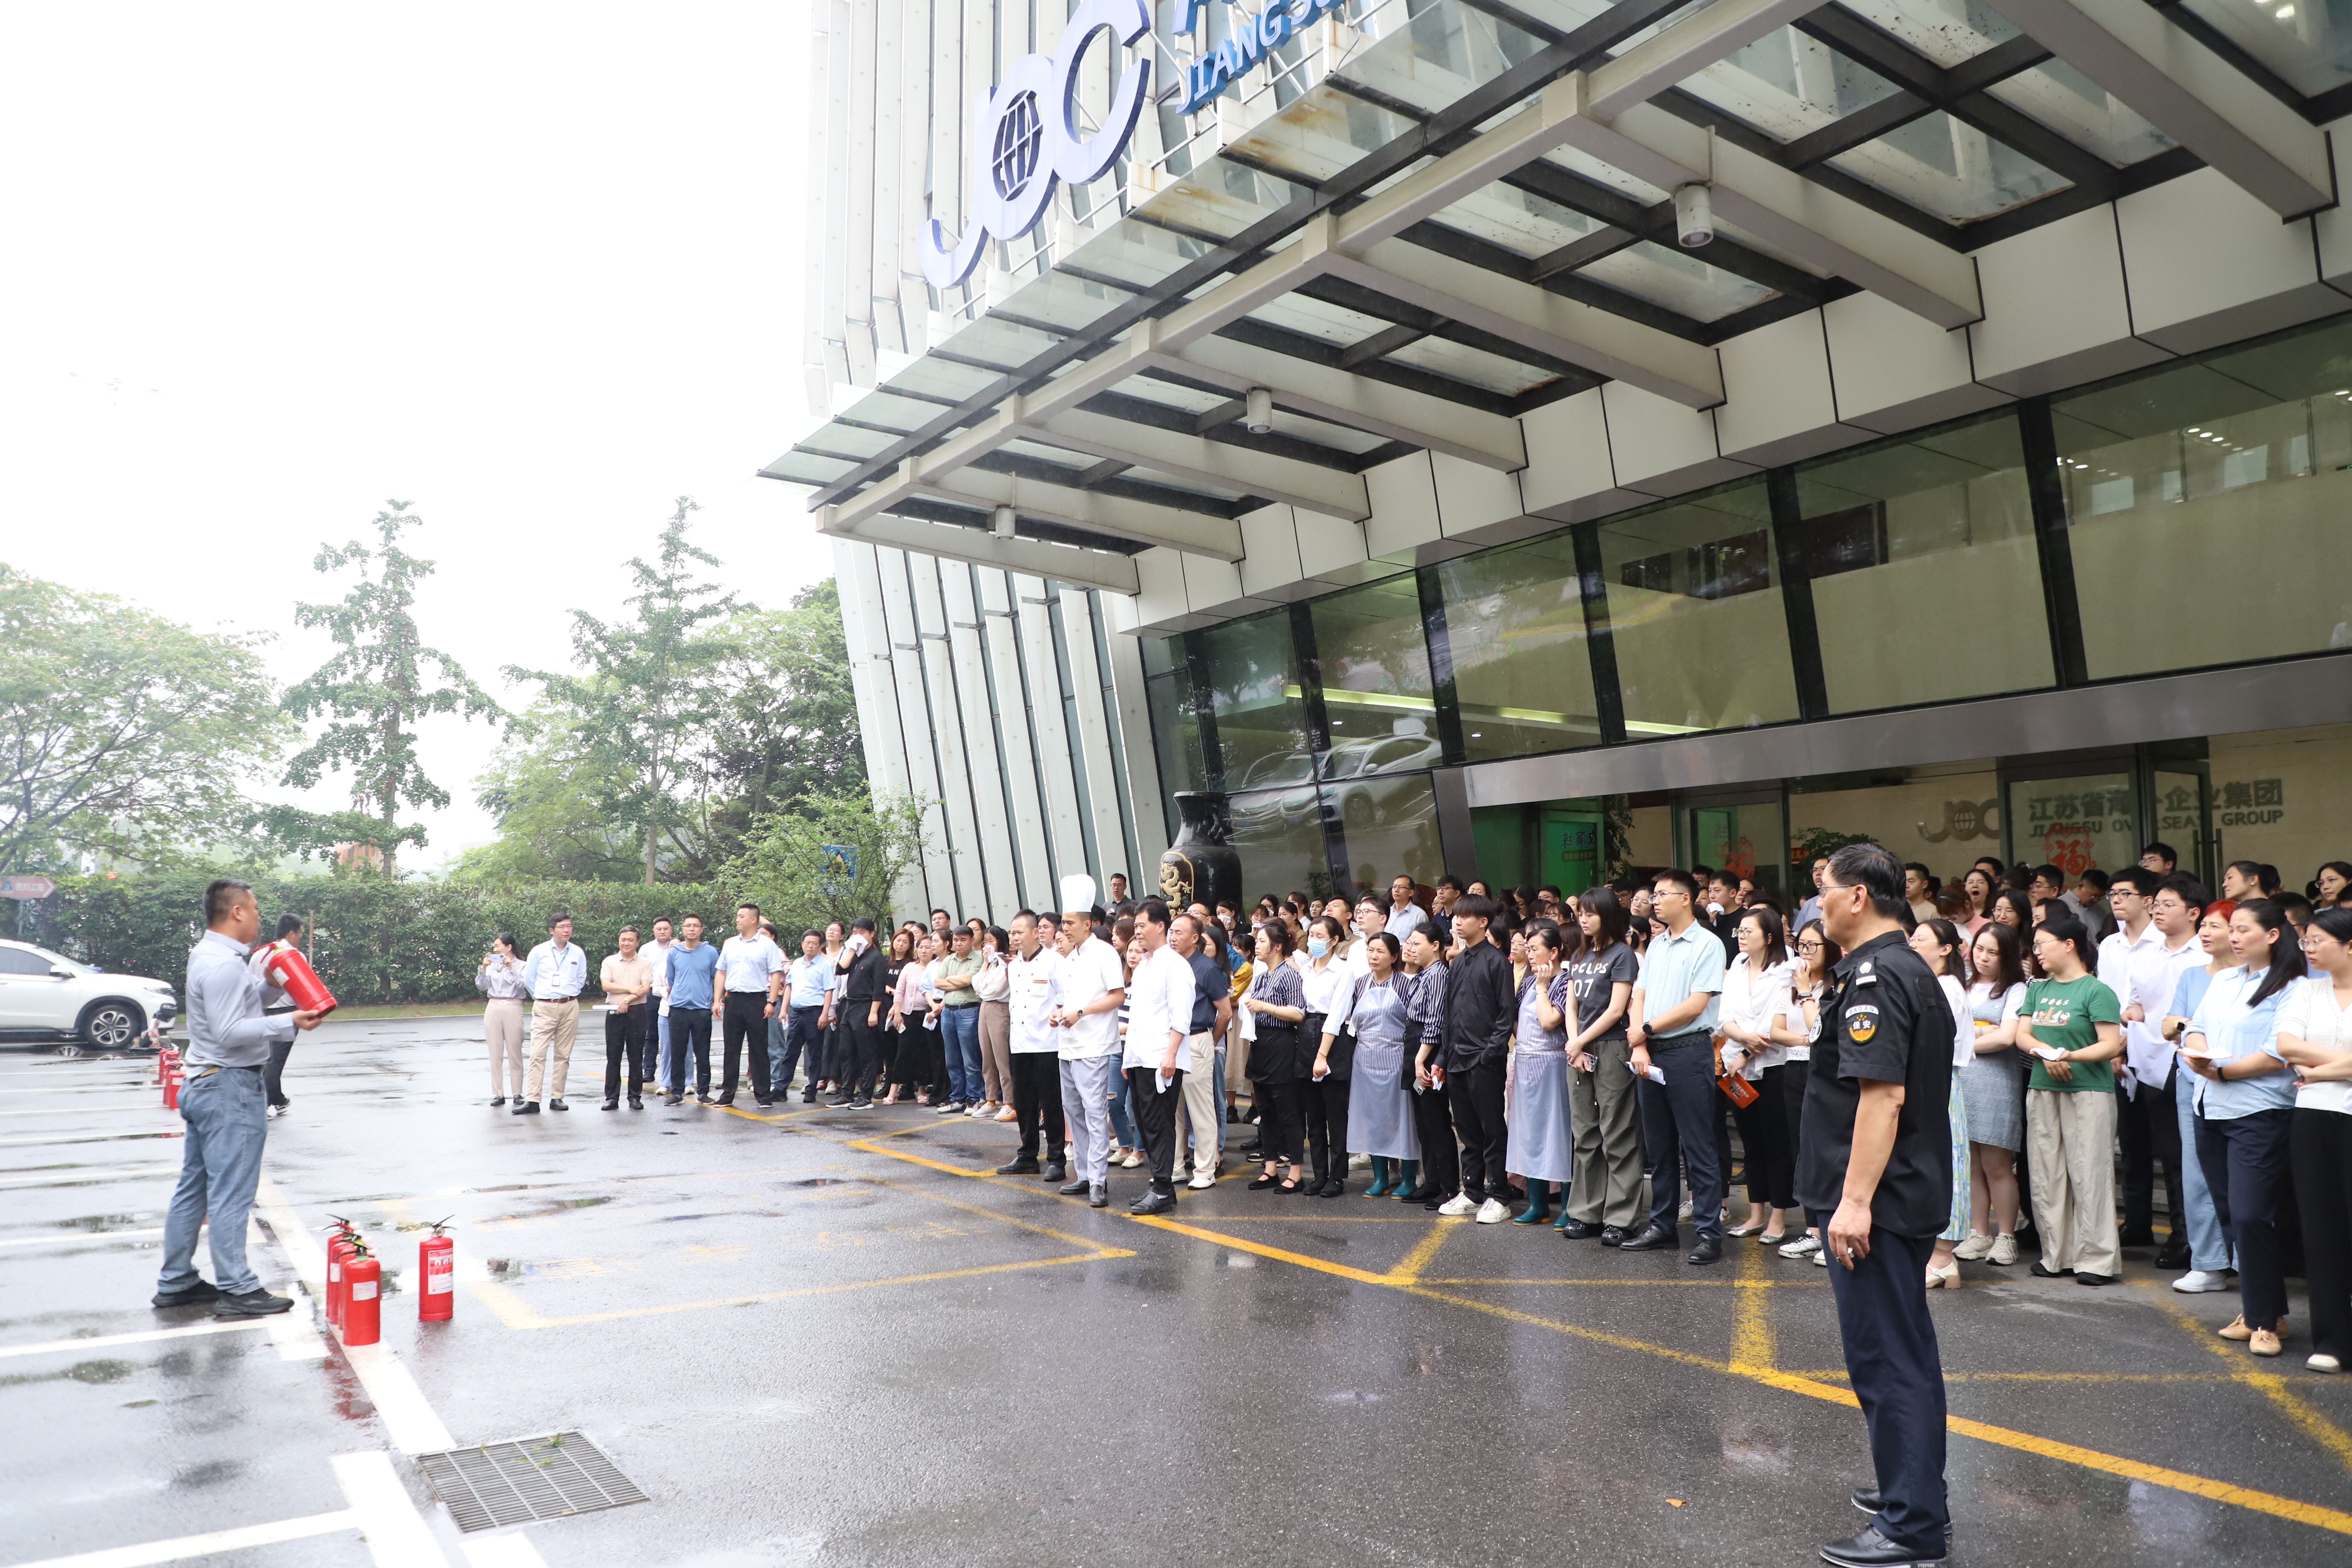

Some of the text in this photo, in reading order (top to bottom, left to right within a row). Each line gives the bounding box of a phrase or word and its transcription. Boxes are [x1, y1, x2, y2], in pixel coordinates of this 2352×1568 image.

[1176, 0, 1331, 115] JIANGS
[2028, 779, 2283, 821] 江苏省海企集团
[2221, 810, 2283, 826] GROUP
[15, 882, 45, 892] 民防工程
[1574, 978, 1594, 998] 07
[1853, 1020, 1871, 1030] 保安
